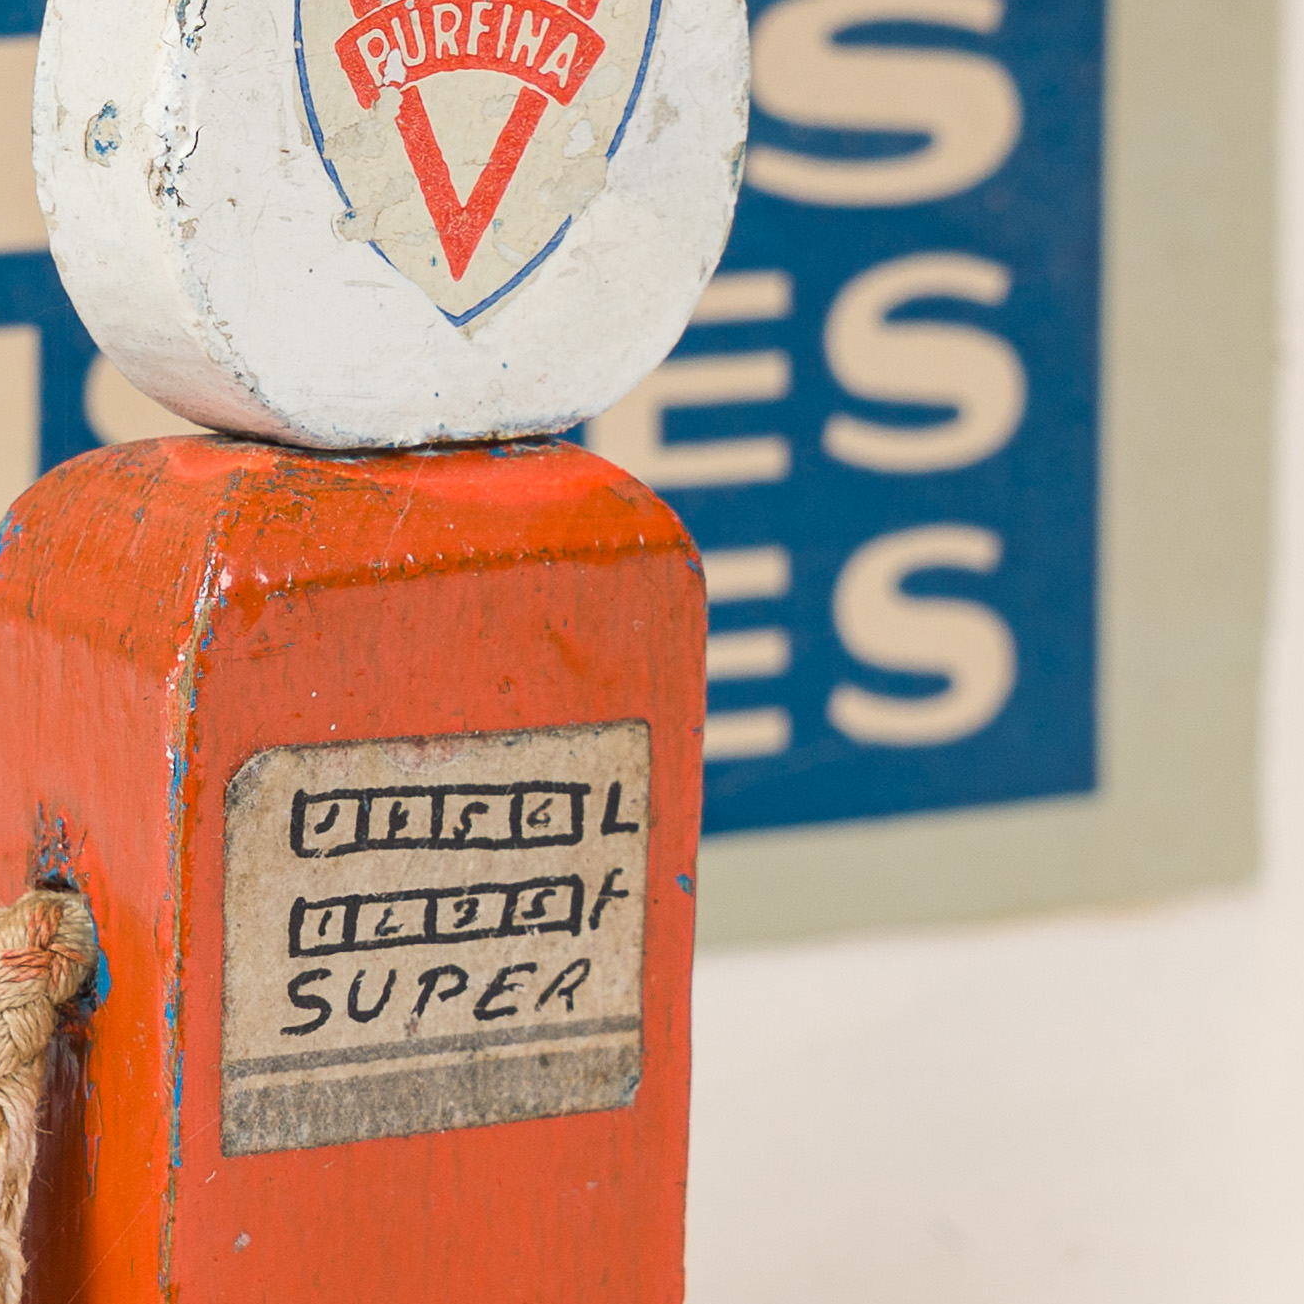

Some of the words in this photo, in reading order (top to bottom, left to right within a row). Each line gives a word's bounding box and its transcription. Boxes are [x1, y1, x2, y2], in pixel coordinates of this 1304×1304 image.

[356, 1, 579, 90] PURFINA
[600, 780, 640, 836] L
[280, 957, 592, 1037] SUPER
